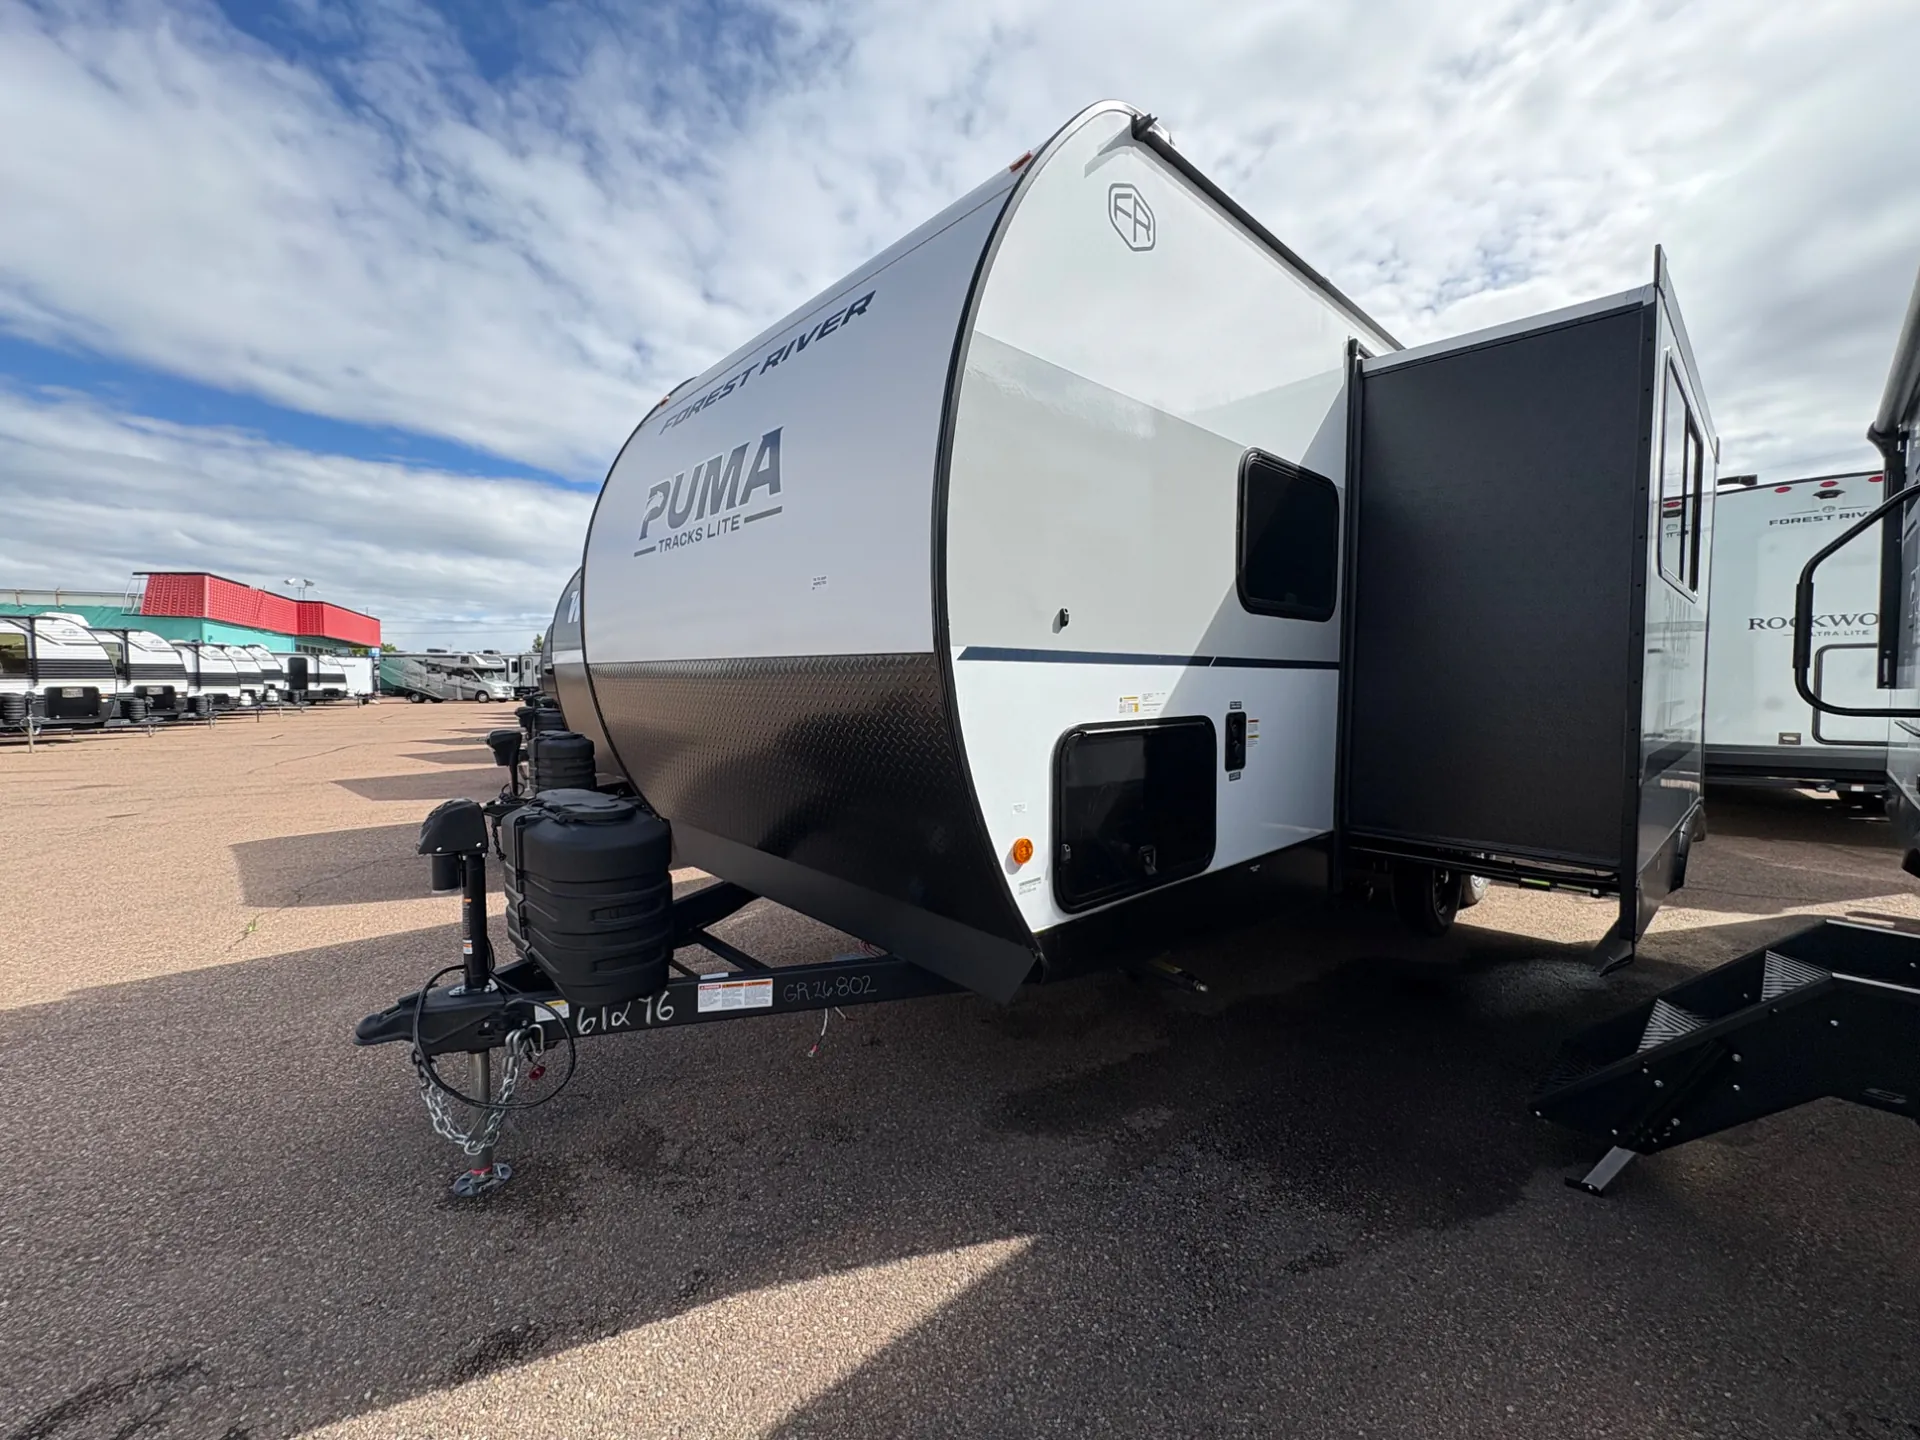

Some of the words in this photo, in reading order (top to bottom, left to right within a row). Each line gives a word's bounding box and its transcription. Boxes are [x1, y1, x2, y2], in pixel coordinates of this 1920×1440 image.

[658, 362, 761, 436] FOREST
[759, 290, 877, 376] RIVER
[638, 425, 785, 541] PUMA
[658, 527, 703, 553] TRACKS
[707, 514, 741, 539] LITE
[1769, 515, 1835, 526] FOREST
[1839, 511, 1874, 520] RIV
[1844, 629, 1870, 637] LITE
